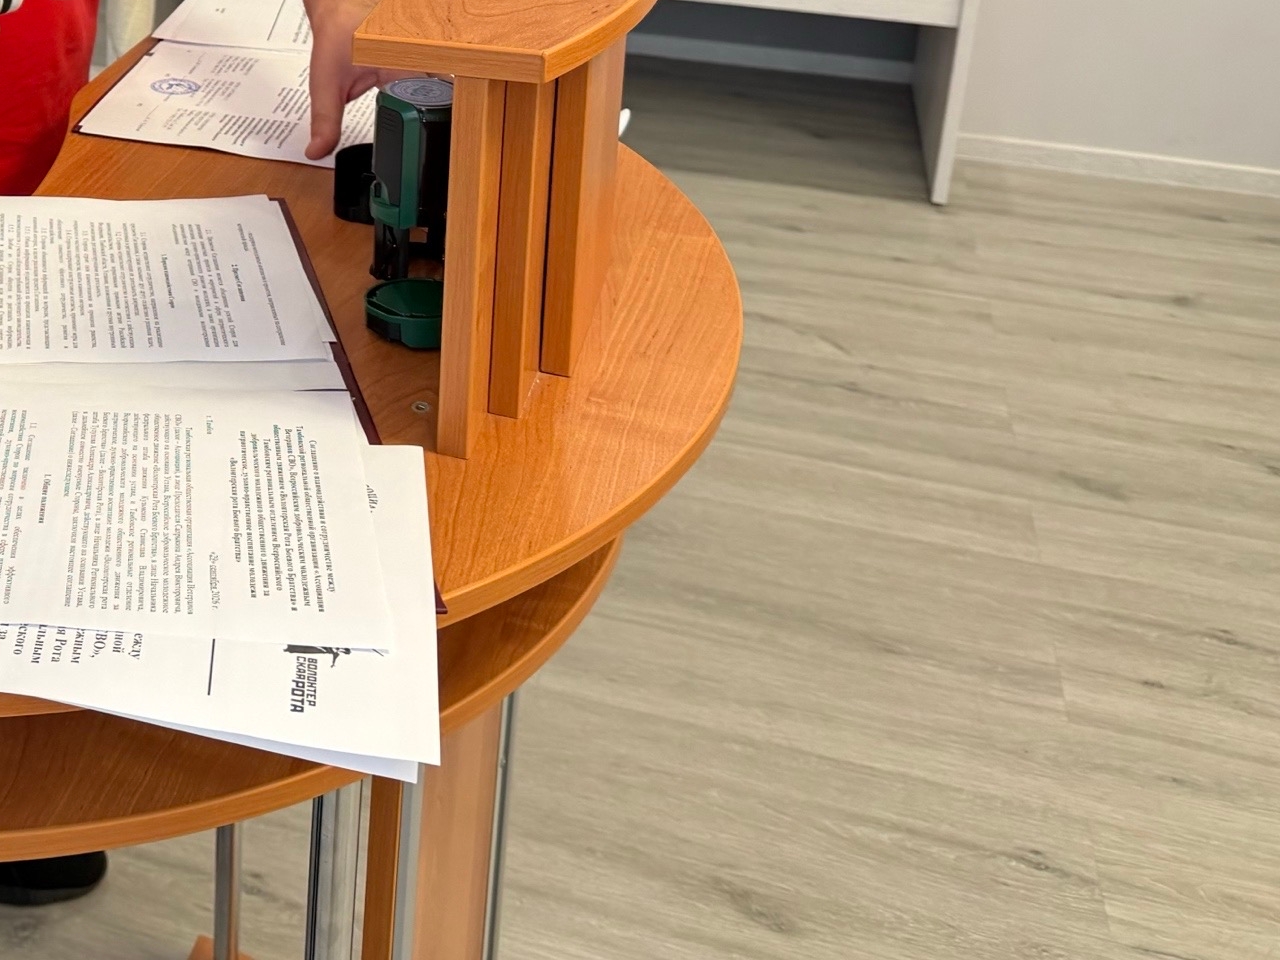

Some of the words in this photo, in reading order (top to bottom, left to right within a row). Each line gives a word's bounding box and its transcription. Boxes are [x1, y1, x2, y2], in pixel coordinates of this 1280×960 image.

[50, 639, 68, 662] Рота
[70, 629, 85, 664] жным
[89, 631, 108, 658] ВО»,
[112, 631, 125, 653] ной
[290, 656, 306, 713] СКАЯРОТА
[306, 657, 318, 707] ВОЛОНТЕР
